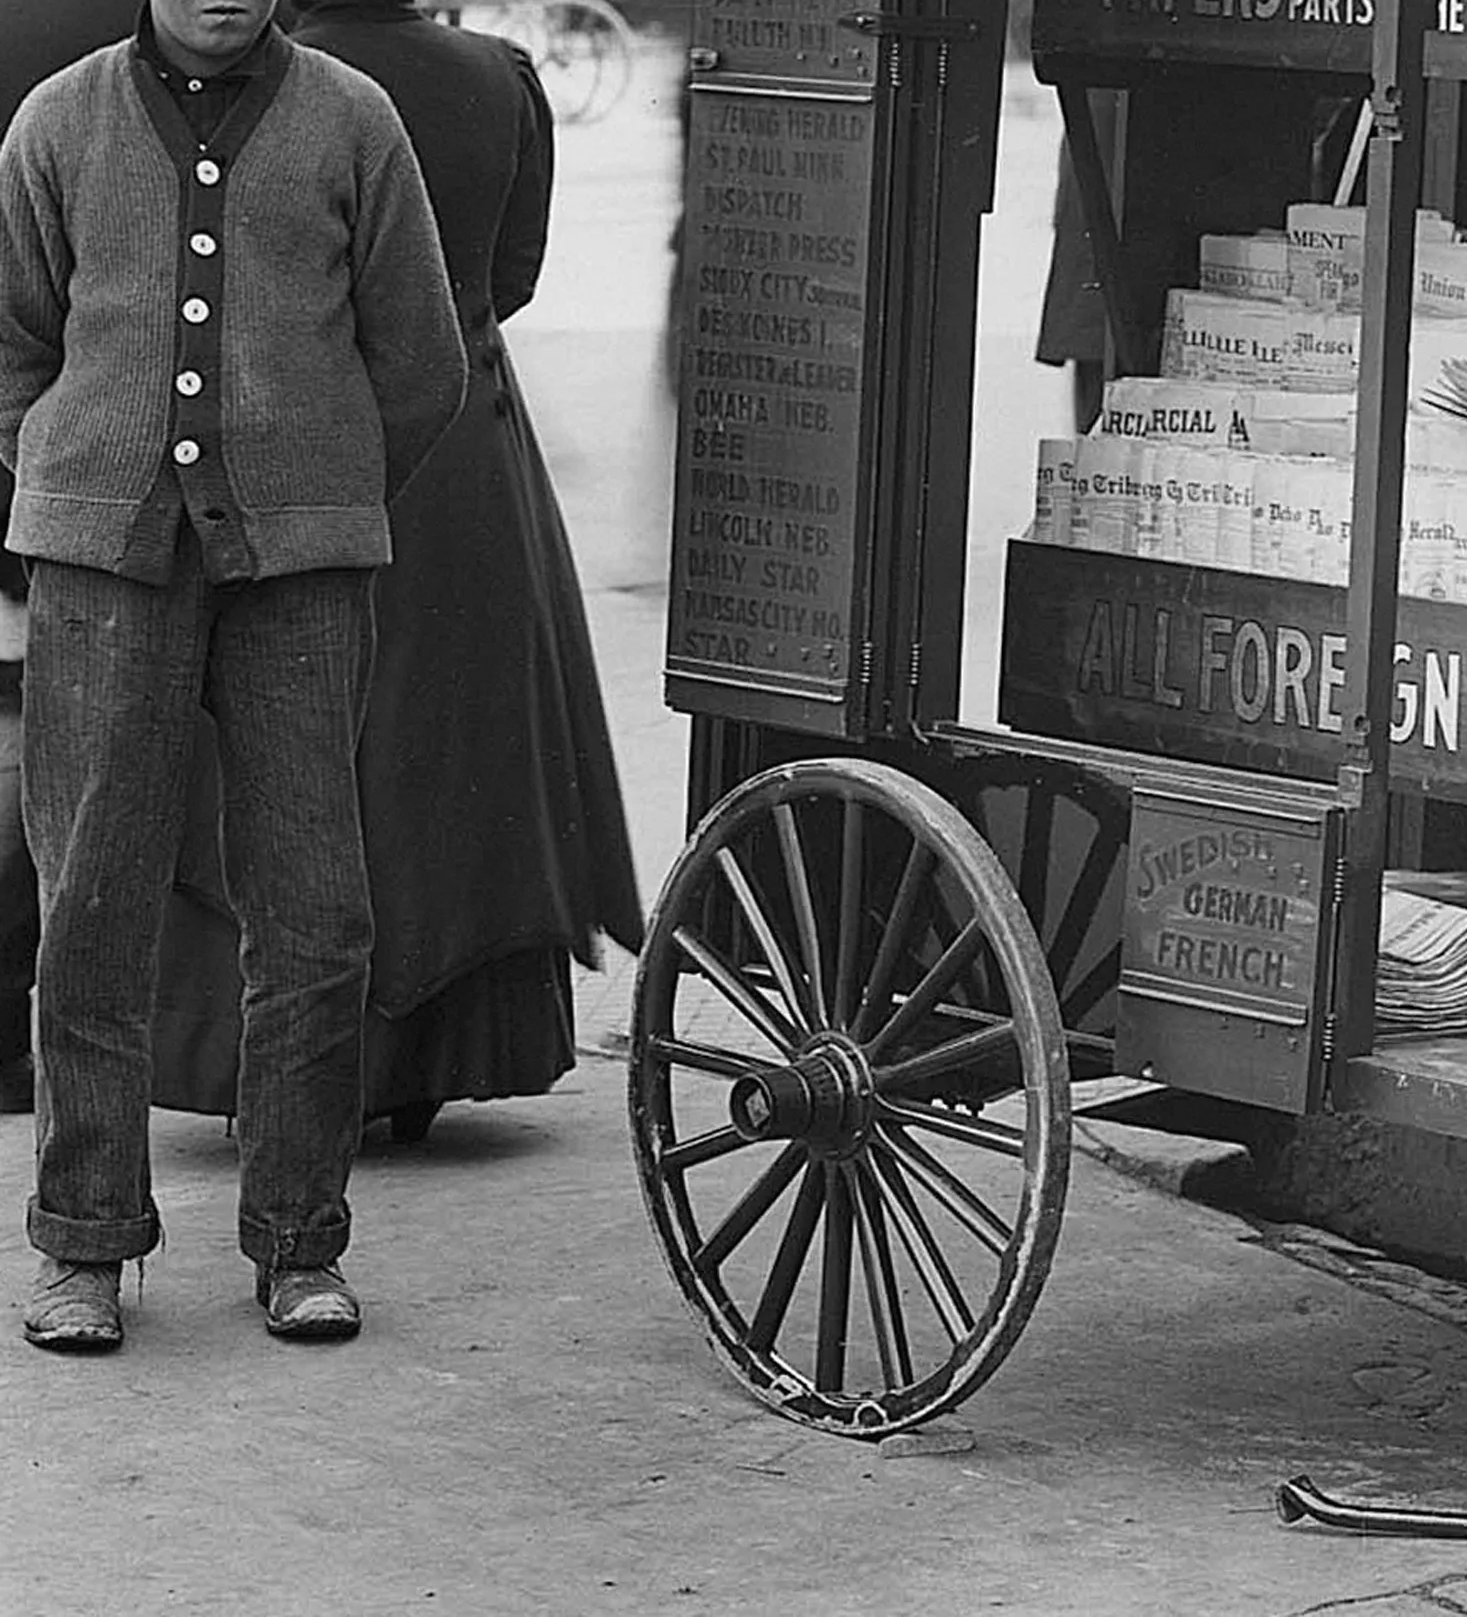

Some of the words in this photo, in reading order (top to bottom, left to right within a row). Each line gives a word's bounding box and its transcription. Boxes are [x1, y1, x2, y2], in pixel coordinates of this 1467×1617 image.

[787, 106, 866, 143] HERALD
[704, 183, 804, 220] DISPATCH
[787, 232, 856, 268] PRESS
[760, 271, 808, 302] CITY
[693, 387, 768, 424] OMAHA
[692, 428, 745, 462] BEE
[760, 474, 840, 515] HERALD
[688, 546, 747, 584] DAILY
[760, 561, 820, 597] STAR
[684, 586, 758, 629] KANSAS
[760, 598, 806, 633] CITY
[1076, 598, 1185, 710] ALL
[1199, 612, 1462, 754] FOREGN
[1136, 829, 1275, 900] SWEDISH
[1182, 882, 1289, 933] GERMAN
[1156, 931, 1286, 989] FRENCH
